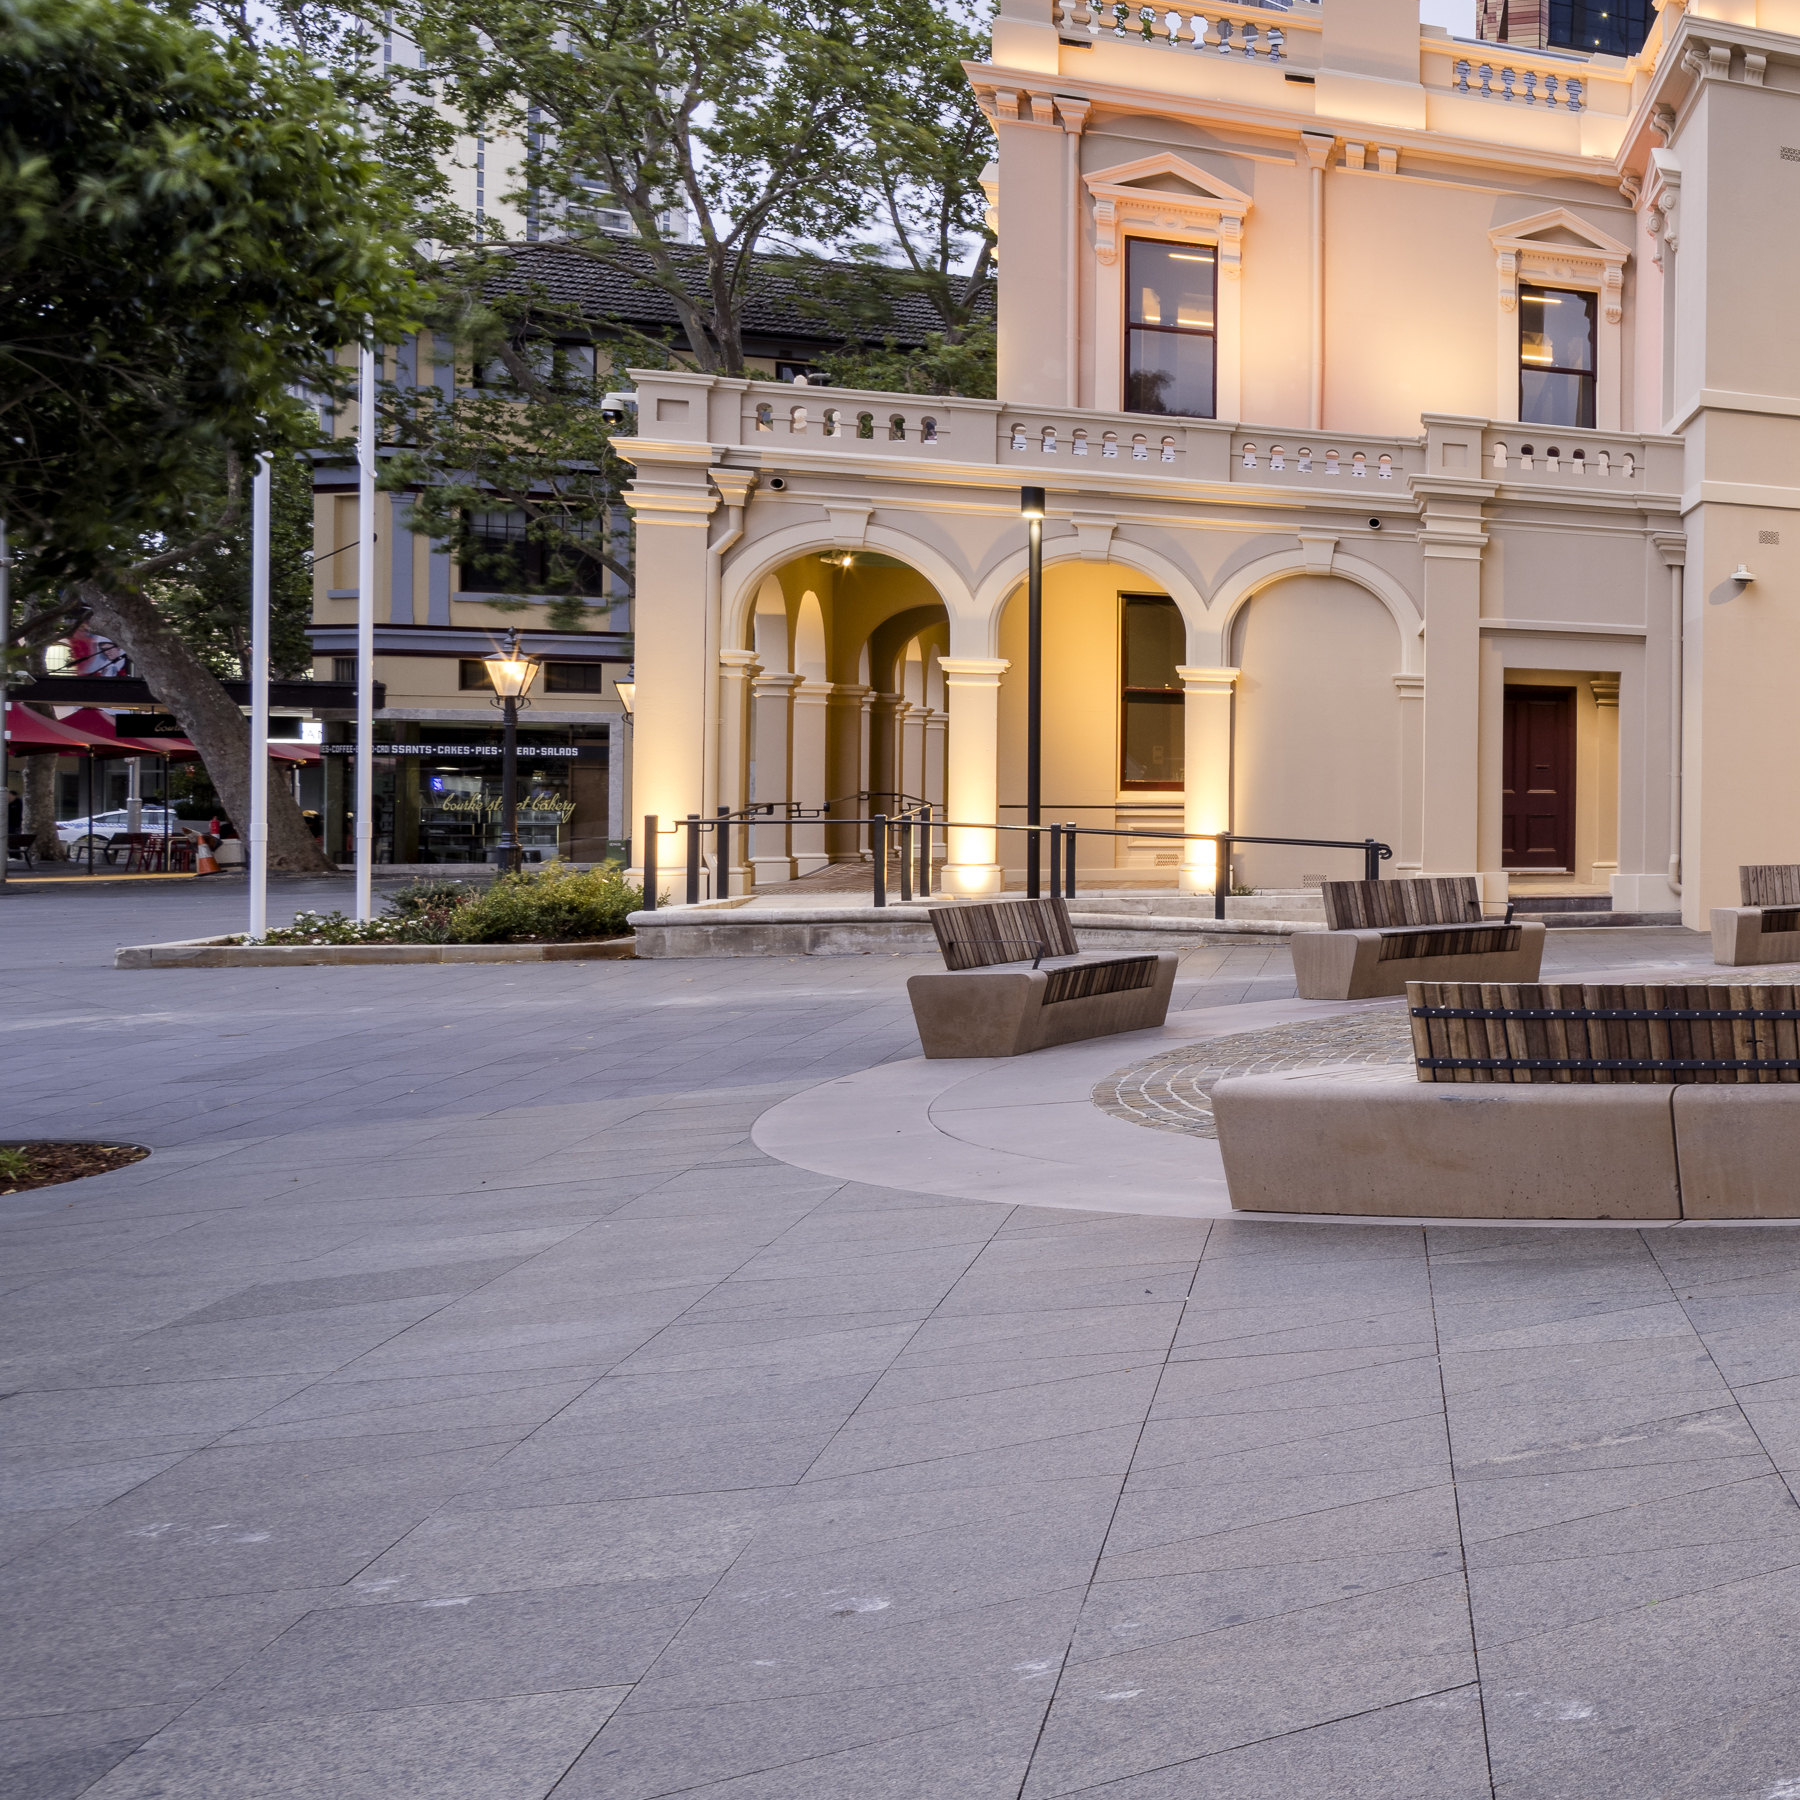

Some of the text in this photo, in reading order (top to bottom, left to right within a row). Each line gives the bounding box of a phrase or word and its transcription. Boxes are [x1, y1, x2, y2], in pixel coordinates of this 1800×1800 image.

[437, 746, 470, 755] CAKES
[475, 746, 498, 755] PIES
[541, 747, 579, 756] SALADS
[442, 792, 577, 824] bourke stet bakery
